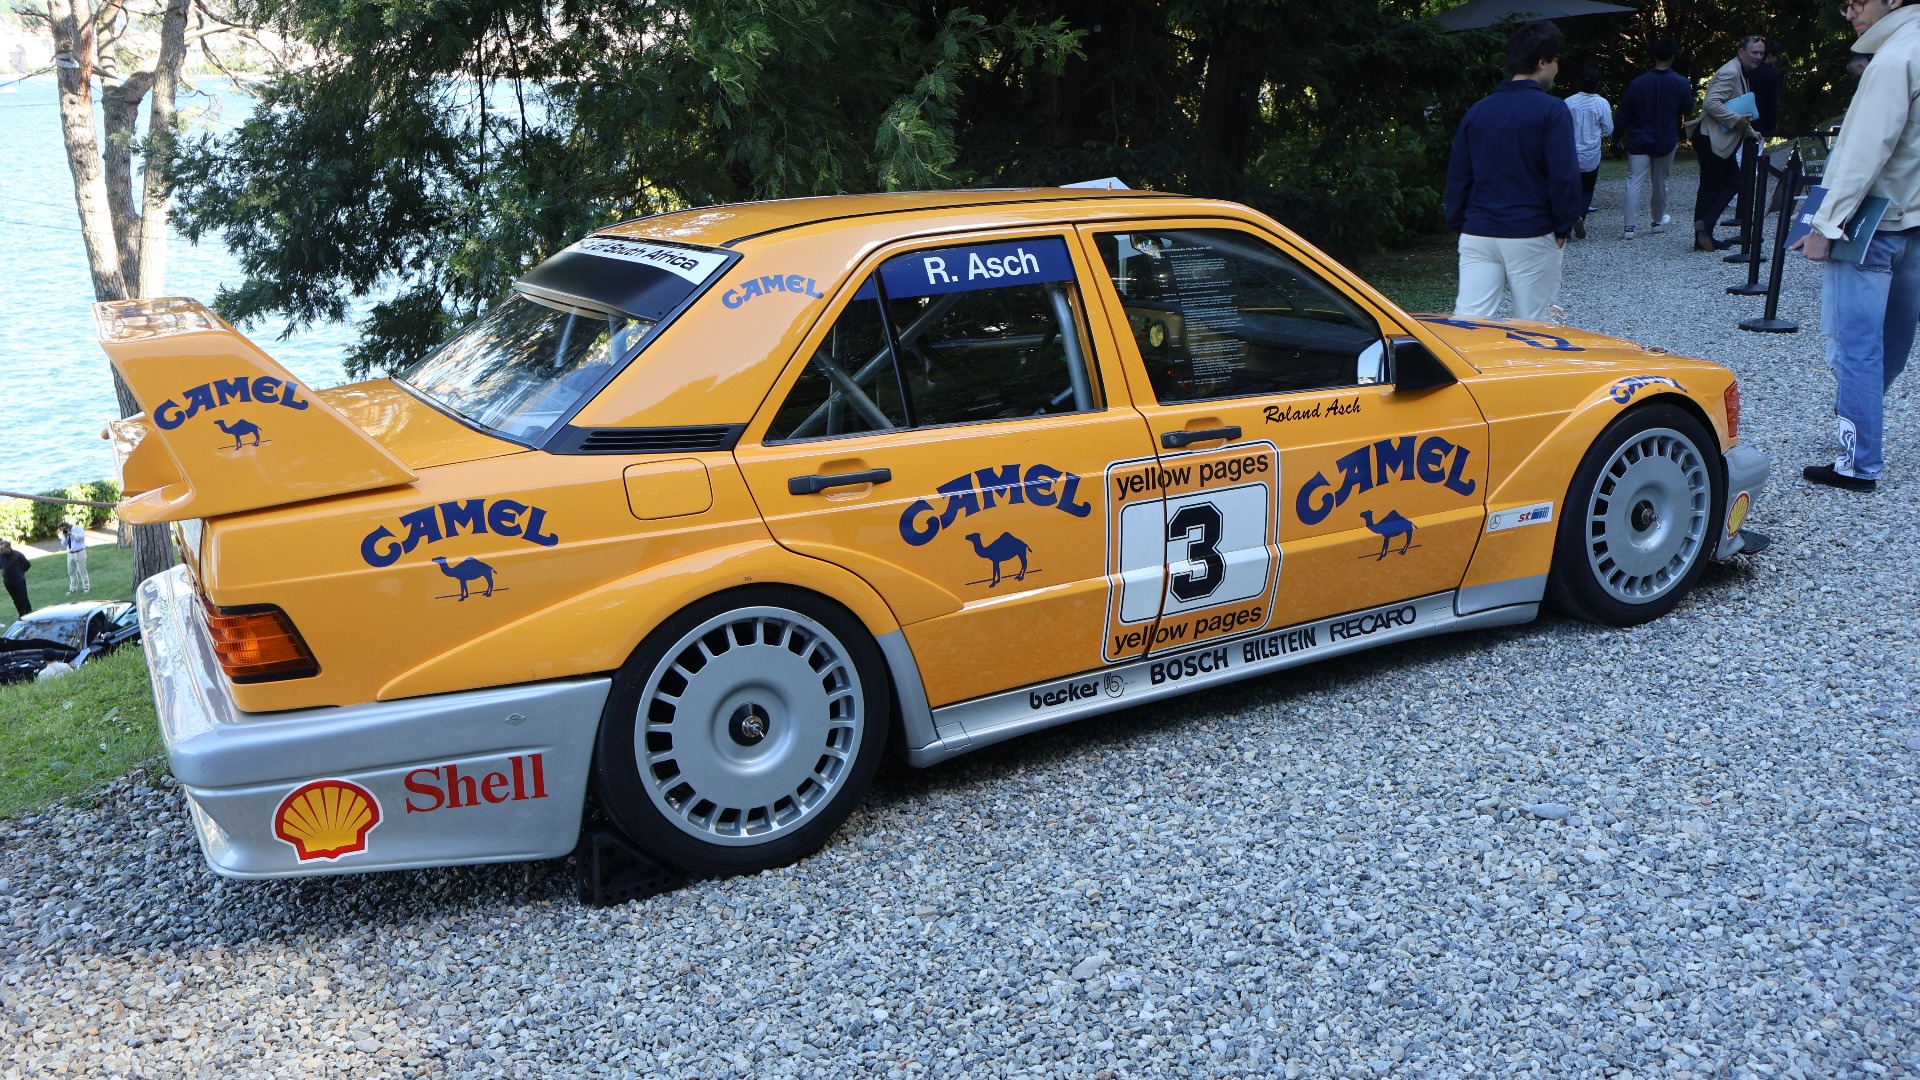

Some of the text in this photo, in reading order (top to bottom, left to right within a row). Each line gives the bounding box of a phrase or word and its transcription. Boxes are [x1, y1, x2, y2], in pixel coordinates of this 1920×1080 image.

[603, 244, 647, 257] South
[642, 249, 699, 272] Africa
[924, 248, 1040, 285] R. Asch
[722, 274, 824, 310] CAMEL
[152, 375, 309, 430] CAMEL
[1263, 397, 1361, 425] Roland Asch
[1116, 454, 1269, 500] yellow pages
[1296, 435, 1476, 526] CAMEL
[361, 498, 559, 568] CAMEL
[899, 464, 1092, 547] CAMEL
[1167, 501, 1226, 603] 3
[1029, 682, 1099, 709] becker
[1150, 647, 1229, 685] BOSCH
[1243, 626, 1317, 663] BILSTEIN
[1330, 605, 1417, 642] RECARO
[1113, 606, 1262, 655] yellow pages
[404, 753, 549, 814] Shell
